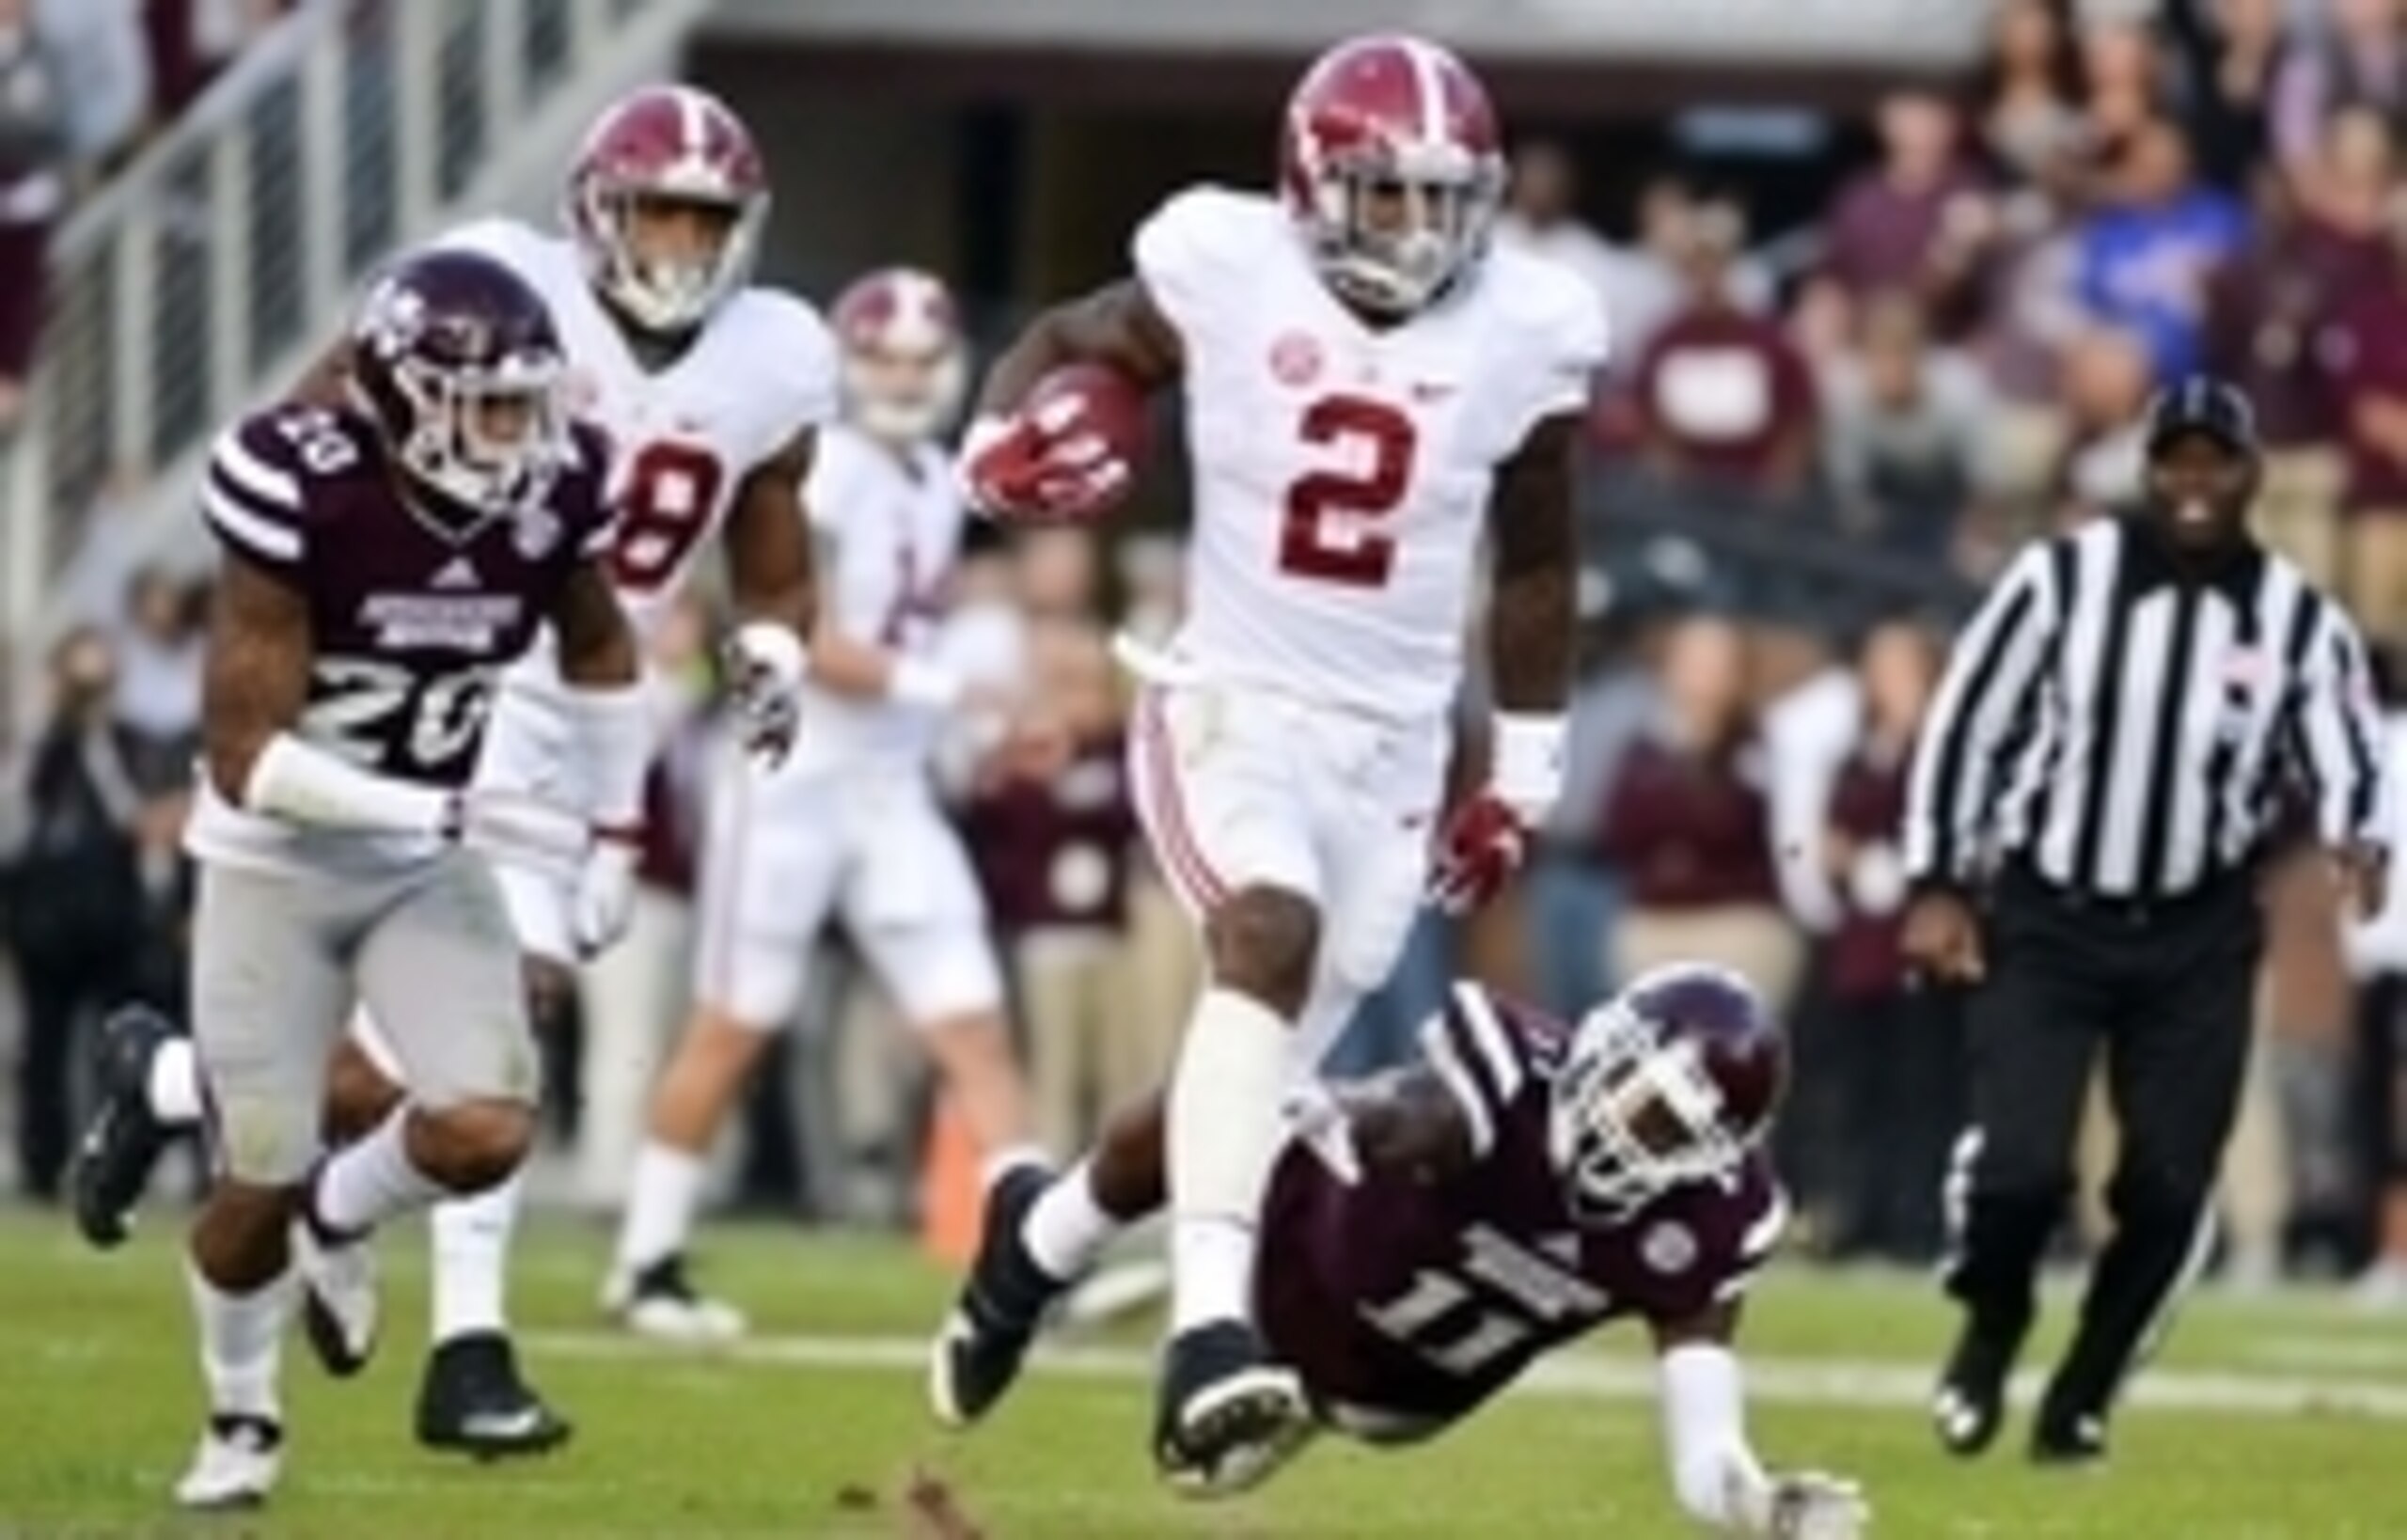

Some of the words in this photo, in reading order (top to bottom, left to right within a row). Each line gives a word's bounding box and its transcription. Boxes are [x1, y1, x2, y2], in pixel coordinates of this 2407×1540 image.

[276, 409, 360, 472] 20
[1280, 392, 1417, 589] 2
[301, 660, 502, 763] 20
[1356, 1267, 1531, 1376] 11
